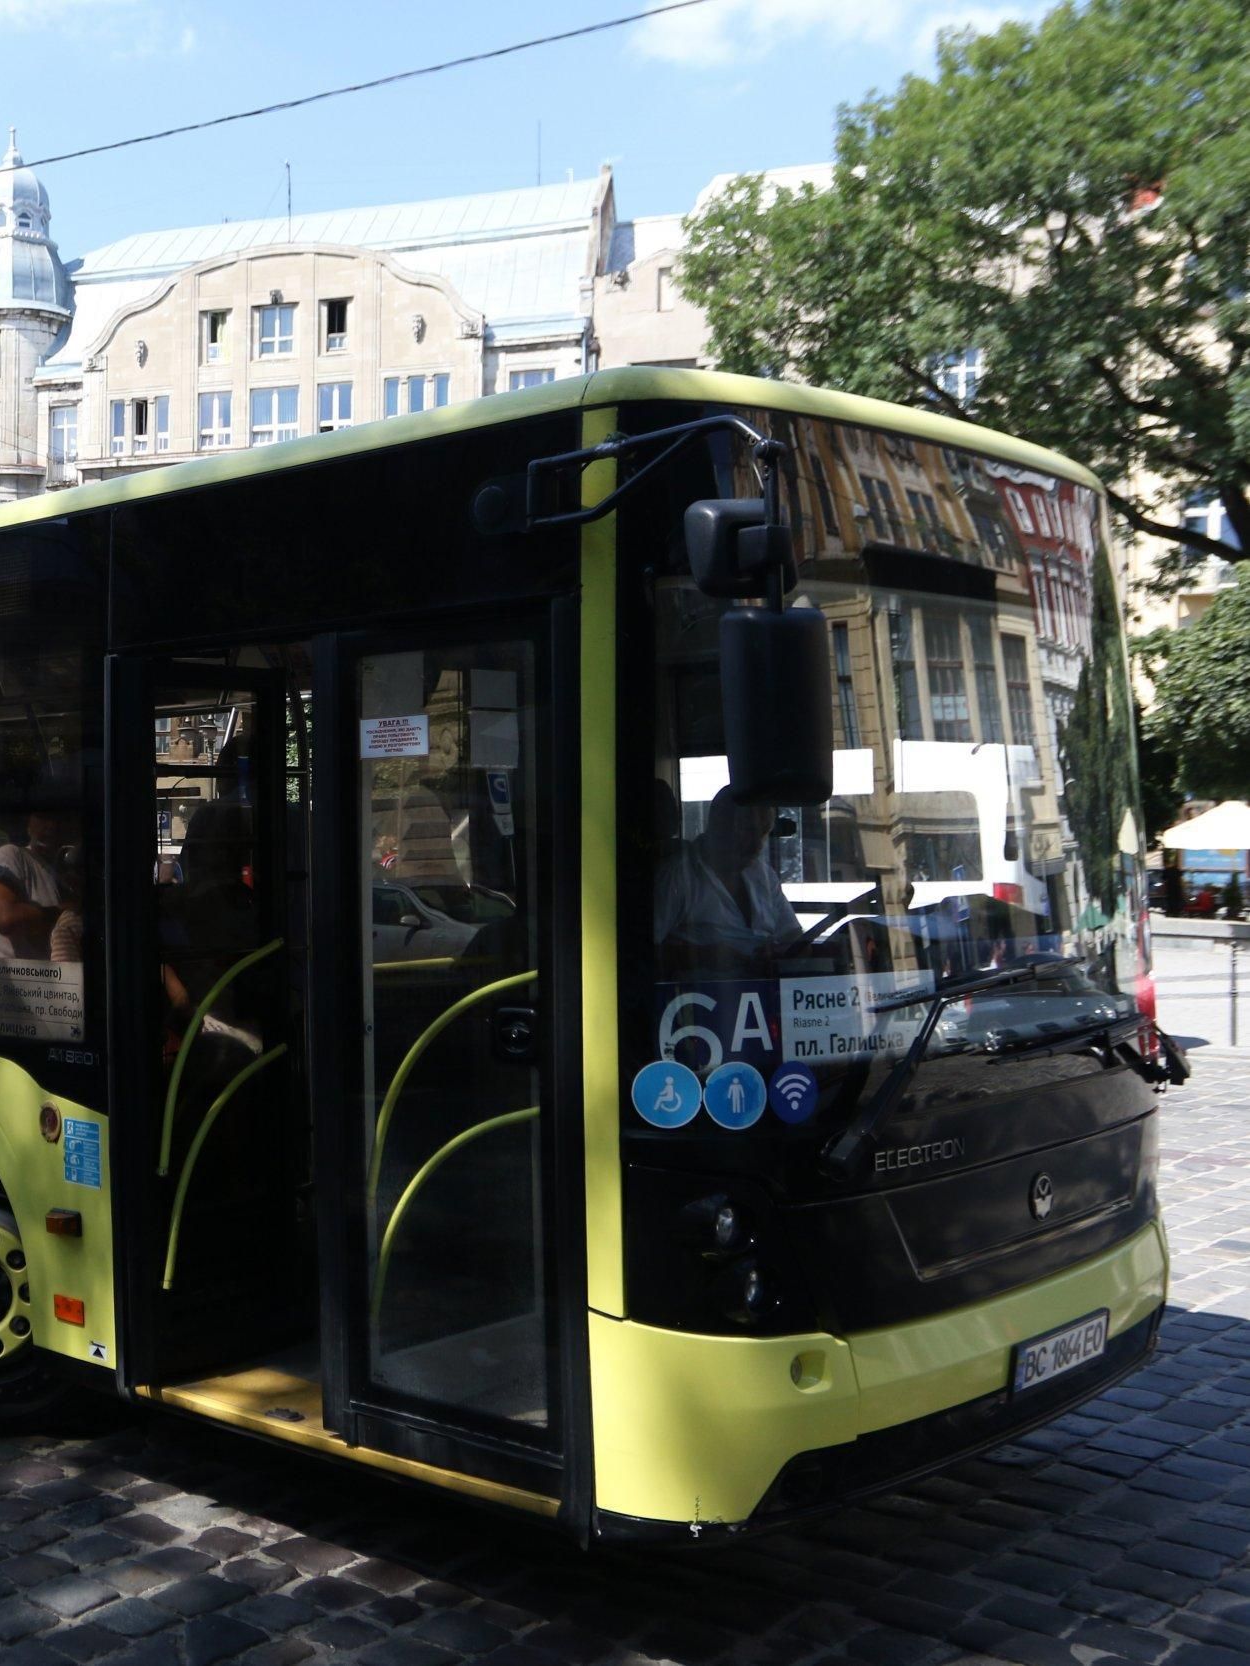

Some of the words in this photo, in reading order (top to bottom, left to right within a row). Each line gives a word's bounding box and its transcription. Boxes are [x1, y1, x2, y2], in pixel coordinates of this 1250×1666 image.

[793, 989, 847, 1010] Рясне
[851, 985, 860, 1007] 2
[48, 1005, 83, 1019] Свободи
[793, 1017, 822, 1028] Riasne
[824, 1015, 830, 1026] 2
[659, 992, 774, 1072] 6А
[795, 1039, 824, 1057] пл.
[830, 1032, 904, 1055] Галицька
[874, 1138, 966, 1172] ELECTRON
[1024, 1346, 1048, 1383] BC
[1051, 1329, 1082, 1371] 1864
